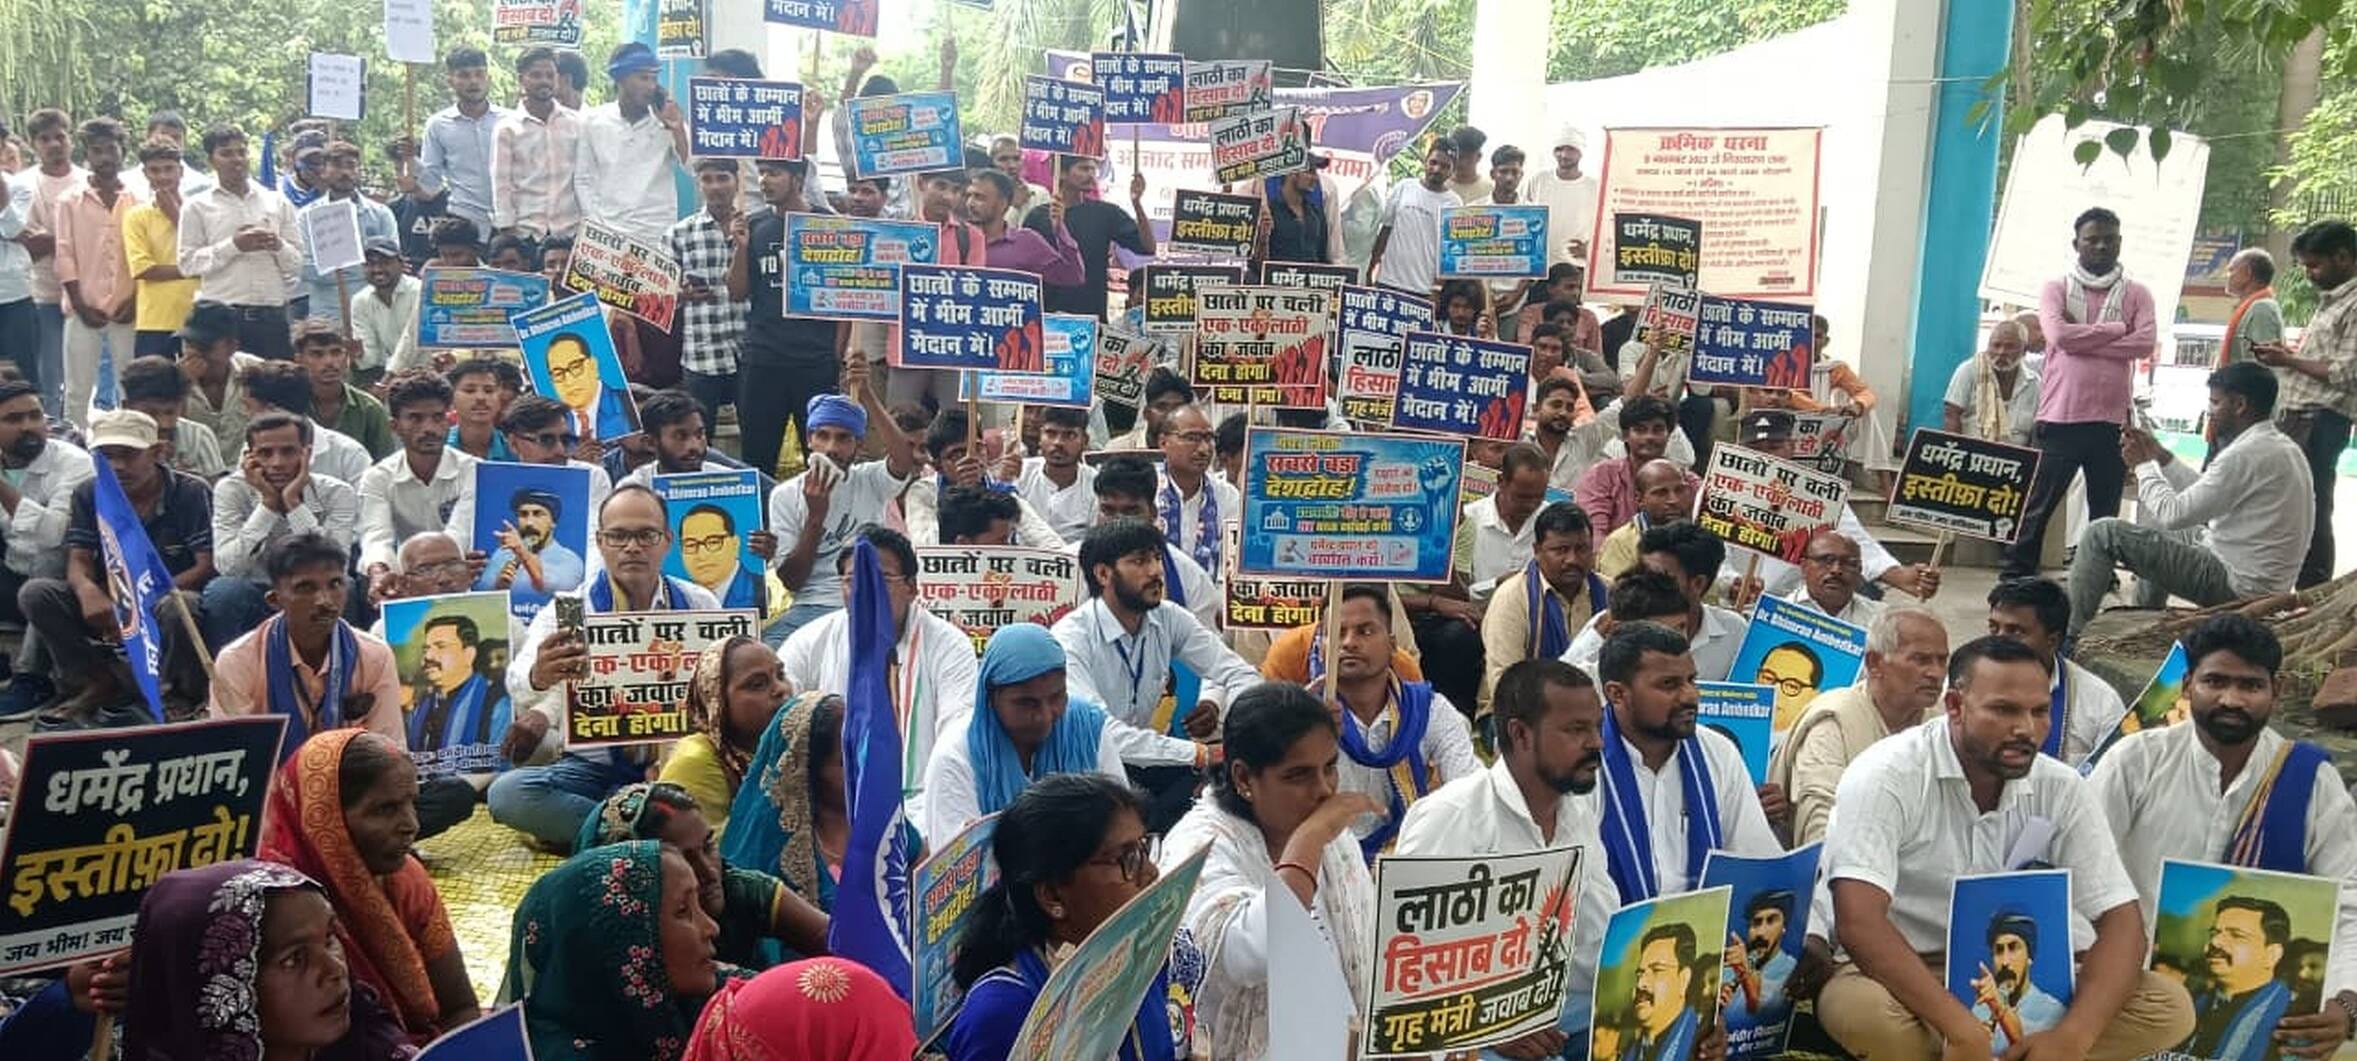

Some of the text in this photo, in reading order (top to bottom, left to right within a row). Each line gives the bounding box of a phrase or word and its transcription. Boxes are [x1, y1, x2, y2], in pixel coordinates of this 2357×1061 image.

[1125, 56, 1140, 73] के
[1189, 64, 1247, 86] लाठी का
[736, 84, 750, 101] के
[754, 86, 799, 105] सम्मान
[696, 105, 784, 125] में भीम आर्मी
[697, 128, 736, 148] मैदान
[1215, 119, 1252, 144] लाठी
[1253, 116, 1274, 134] का
[1216, 140, 1259, 165] हिसाब
[1724, 136, 1769, 151] धरना
[1183, 193, 1215, 216] धर्मेंद्र
[1623, 218, 1660, 239] धर्मेंद्र
[908, 270, 958, 296] छात्रों
[961, 271, 982, 297] के
[986, 278, 1039, 303] सम्मान
[910, 298, 929, 323] में
[934, 299, 973, 324] भीम
[980, 302, 1025, 328] आर्मी
[1255, 295, 1275, 311] पर
[1281, 294, 1326, 314] चली
[1382, 294, 1396, 312] के
[1701, 301, 1811, 329] छात्रों के सम्मान
[1345, 308, 1388, 332] में भीम
[910, 329, 963, 355] मैदान
[1104, 336, 1130, 354] का
[1699, 323, 1793, 350] में भीम आर्मी
[1203, 341, 1276, 359] का जवाब
[1408, 337, 1529, 374] छात्रों के सम्मान
[1696, 350, 1737, 373] मैदान
[1199, 361, 1230, 381] देना
[1346, 365, 1399, 393] हिसा
[1405, 362, 1510, 398] में भीम आर्मी
[1401, 392, 1450, 420] मैदान
[1920, 441, 2022, 485] धर्मेंद्र प्रधान,
[1719, 451, 1846, 503] छात्रों पर चली
[1709, 496, 1736, 514] का
[1902, 473, 2022, 516] इस्तीफ़ा दो!
[920, 551, 1076, 580] छात्रों पर चली
[1011, 580, 1060, 602] लाठी
[1267, 581, 1328, 598] जवाब
[1230, 600, 1266, 622] देना
[587, 615, 752, 645] ात्रों पर चली
[589, 652, 672, 675] क-एक
[577, 685, 615, 706] का
[574, 709, 620, 737] देना
[44, 748, 249, 817] धर्मेंद्र प्रधान,
[9, 804, 250, 918] इस्तीफ़ा दो!
[1393, 862, 1541, 934] लाठी का
[3, 942, 40, 964] जय
[94, 929, 124, 948] जय
[1384, 915, 1532, 994] हिसाब दो,
[1384, 972, 1561, 1052] गृह मंत्री जवाब दो!
